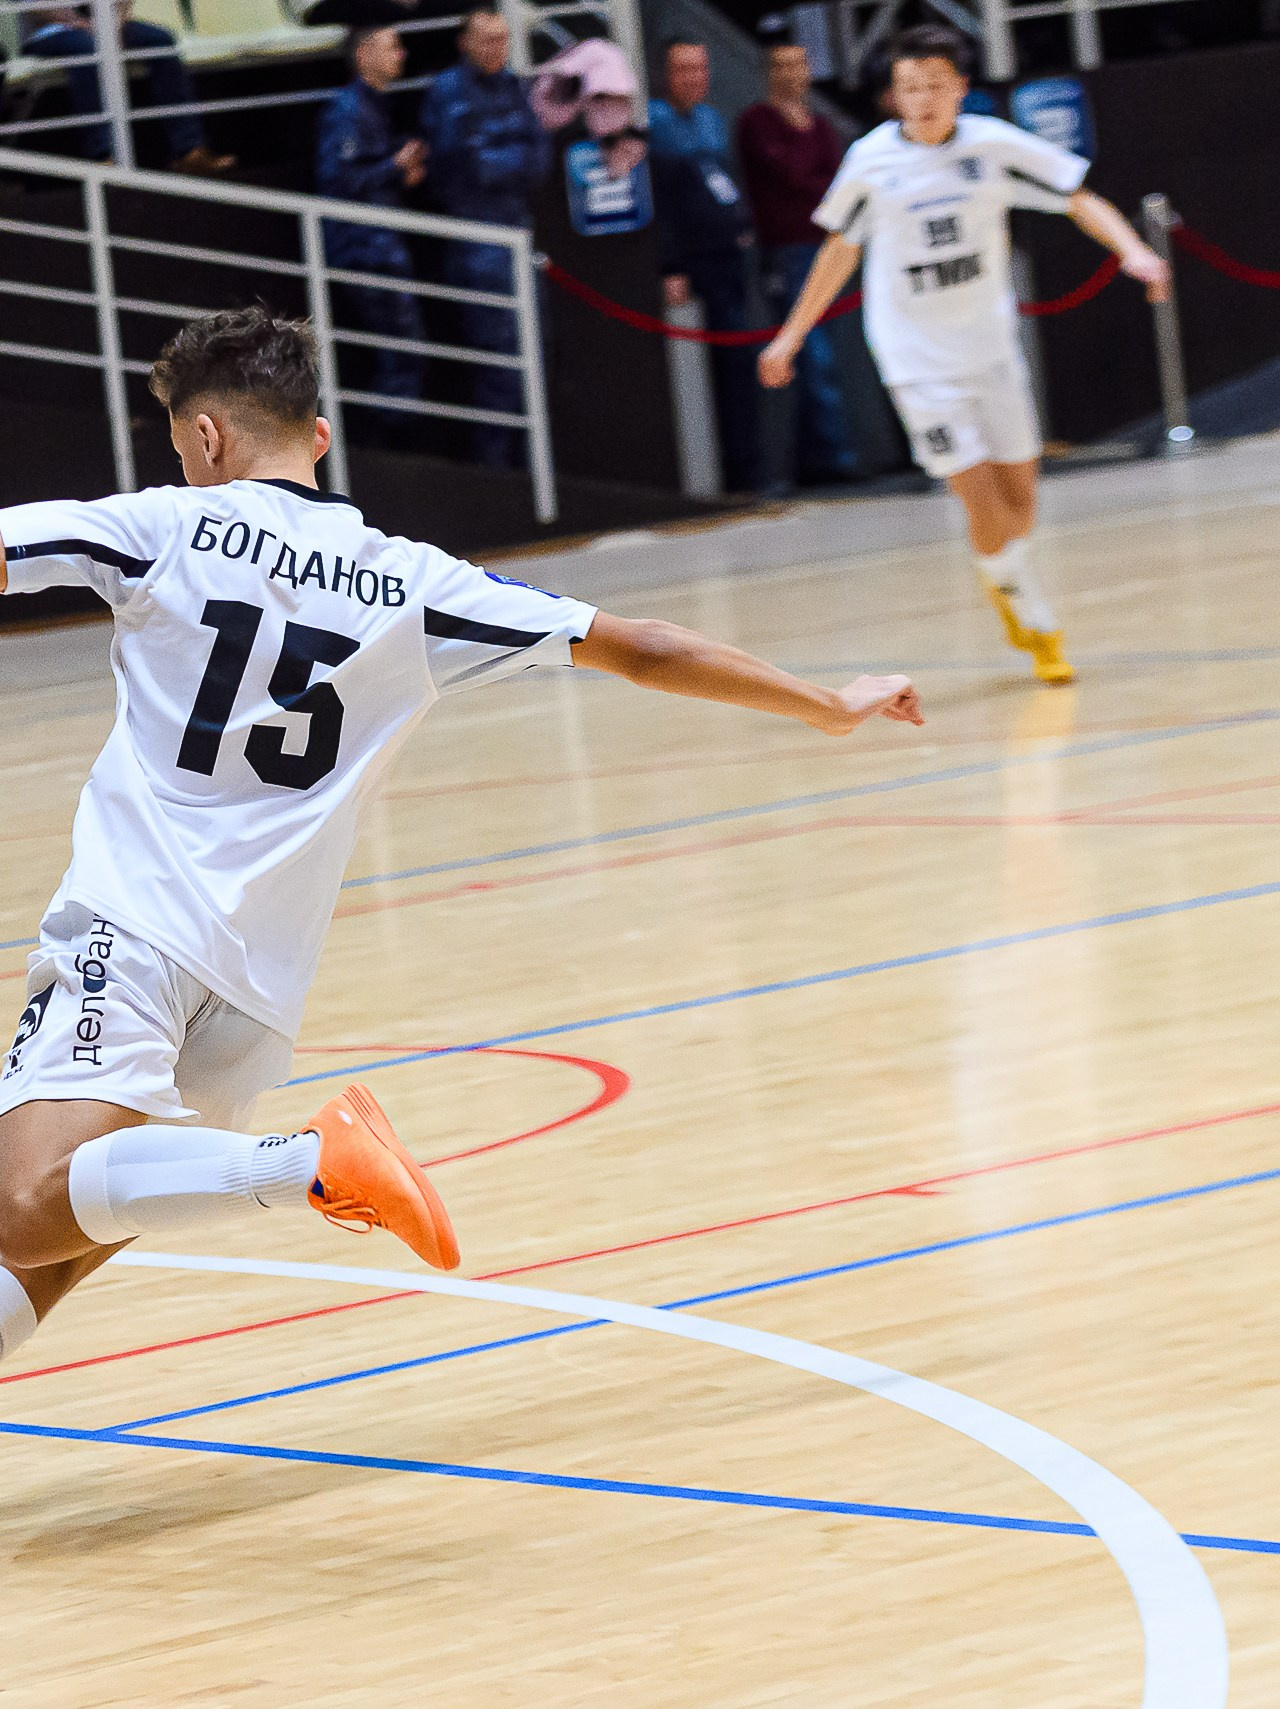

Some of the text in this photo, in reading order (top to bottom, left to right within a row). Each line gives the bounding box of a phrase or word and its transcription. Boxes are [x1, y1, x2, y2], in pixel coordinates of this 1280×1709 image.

[190, 515, 406, 607] БОГДАНОВ
[176, 598, 361, 791] 15
[73, 913, 115, 1066] делобан
